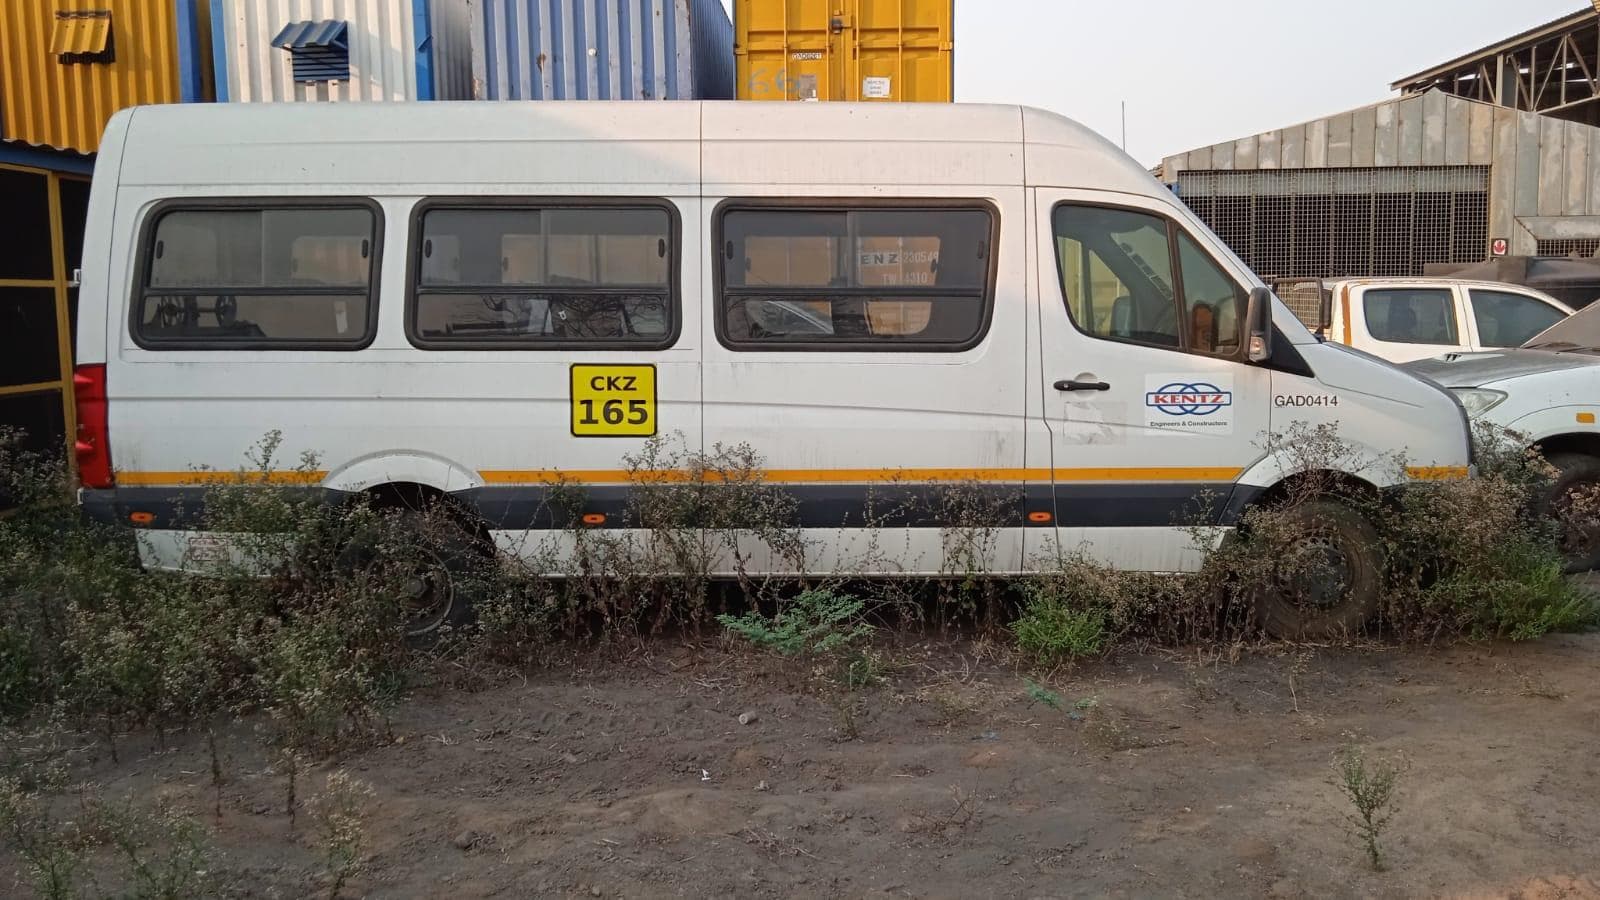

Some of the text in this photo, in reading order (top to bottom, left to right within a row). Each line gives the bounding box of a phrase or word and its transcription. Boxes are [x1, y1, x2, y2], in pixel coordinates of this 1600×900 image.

[590, 375, 637, 392] CKZ
[1154, 394, 1225, 404] KENTZ
[1274, 395, 1338, 407] GAD0414
[579, 399, 648, 425] 165
